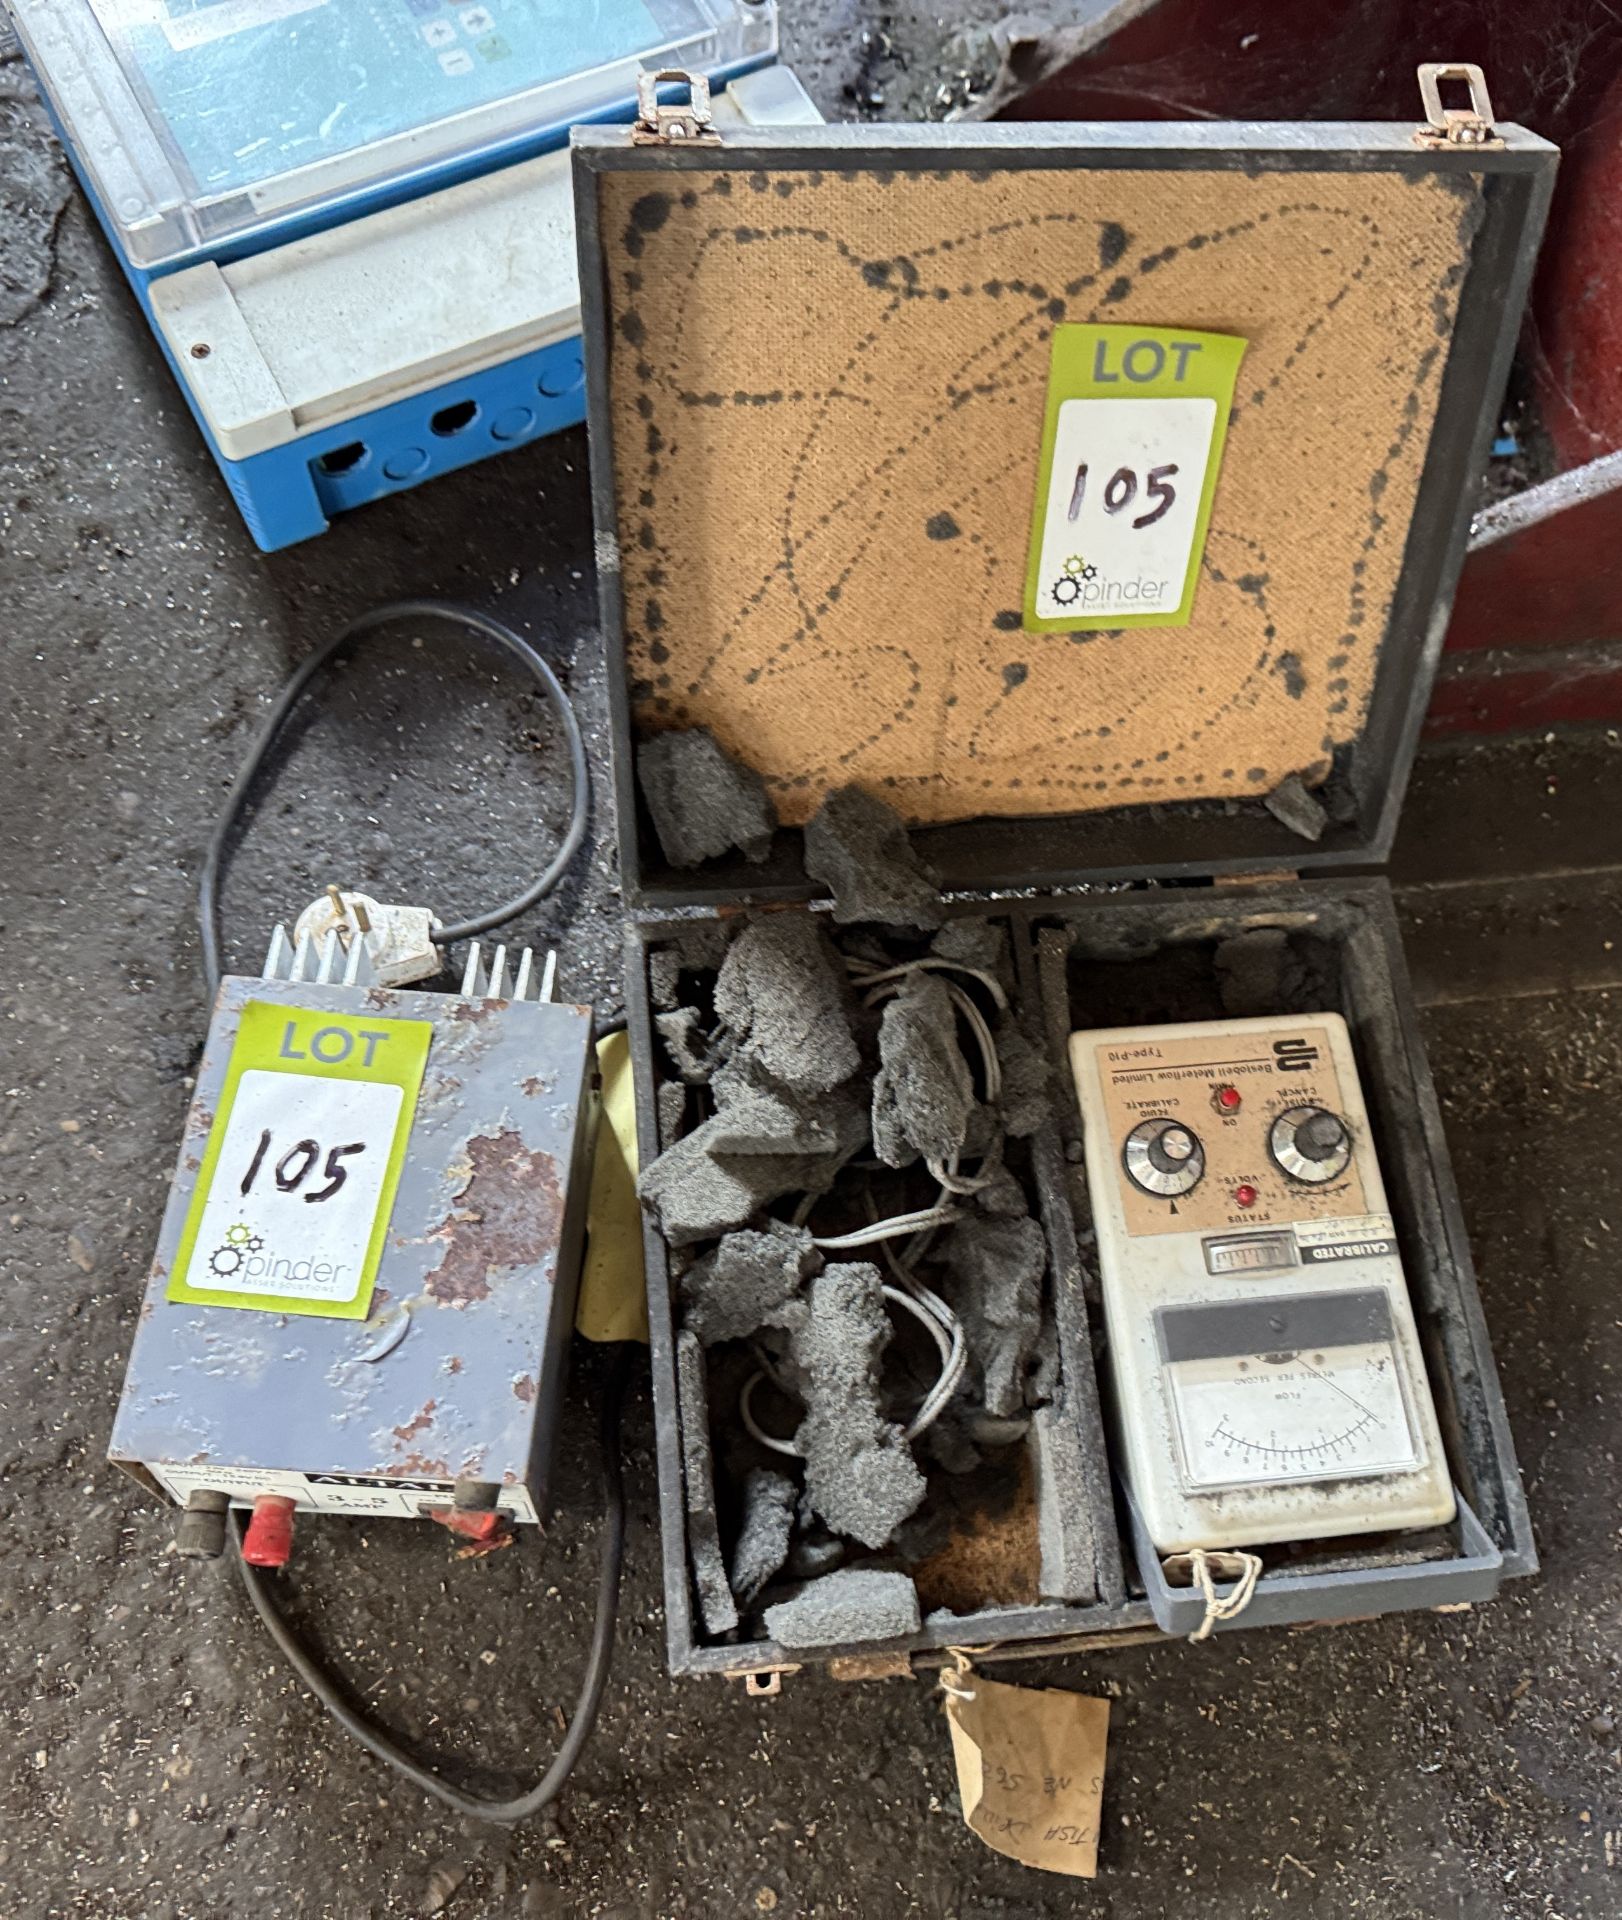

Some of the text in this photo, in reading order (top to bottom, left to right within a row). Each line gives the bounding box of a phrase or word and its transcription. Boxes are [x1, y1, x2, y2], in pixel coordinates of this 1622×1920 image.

[1092, 339, 1203, 383] LOT
[1067, 461, 1180, 530] 105
[1081, 575, 1169, 610] pinder
[279, 1021, 391, 1067] LOT
[1112, 1064, 1273, 1085] Bestobell Meterflow Limited
[1125, 1098, 1181, 1110] CALIBRATE
[1222, 1118, 1238, 1127] ON
[241, 1128, 367, 1204] 105
[1227, 1213, 1271, 1224] STATUS
[1312, 1242, 1389, 1260] CALIBRATED
[243, 1251, 348, 1284] pinder
[1275, 1391, 1301, 1400] FLOW
